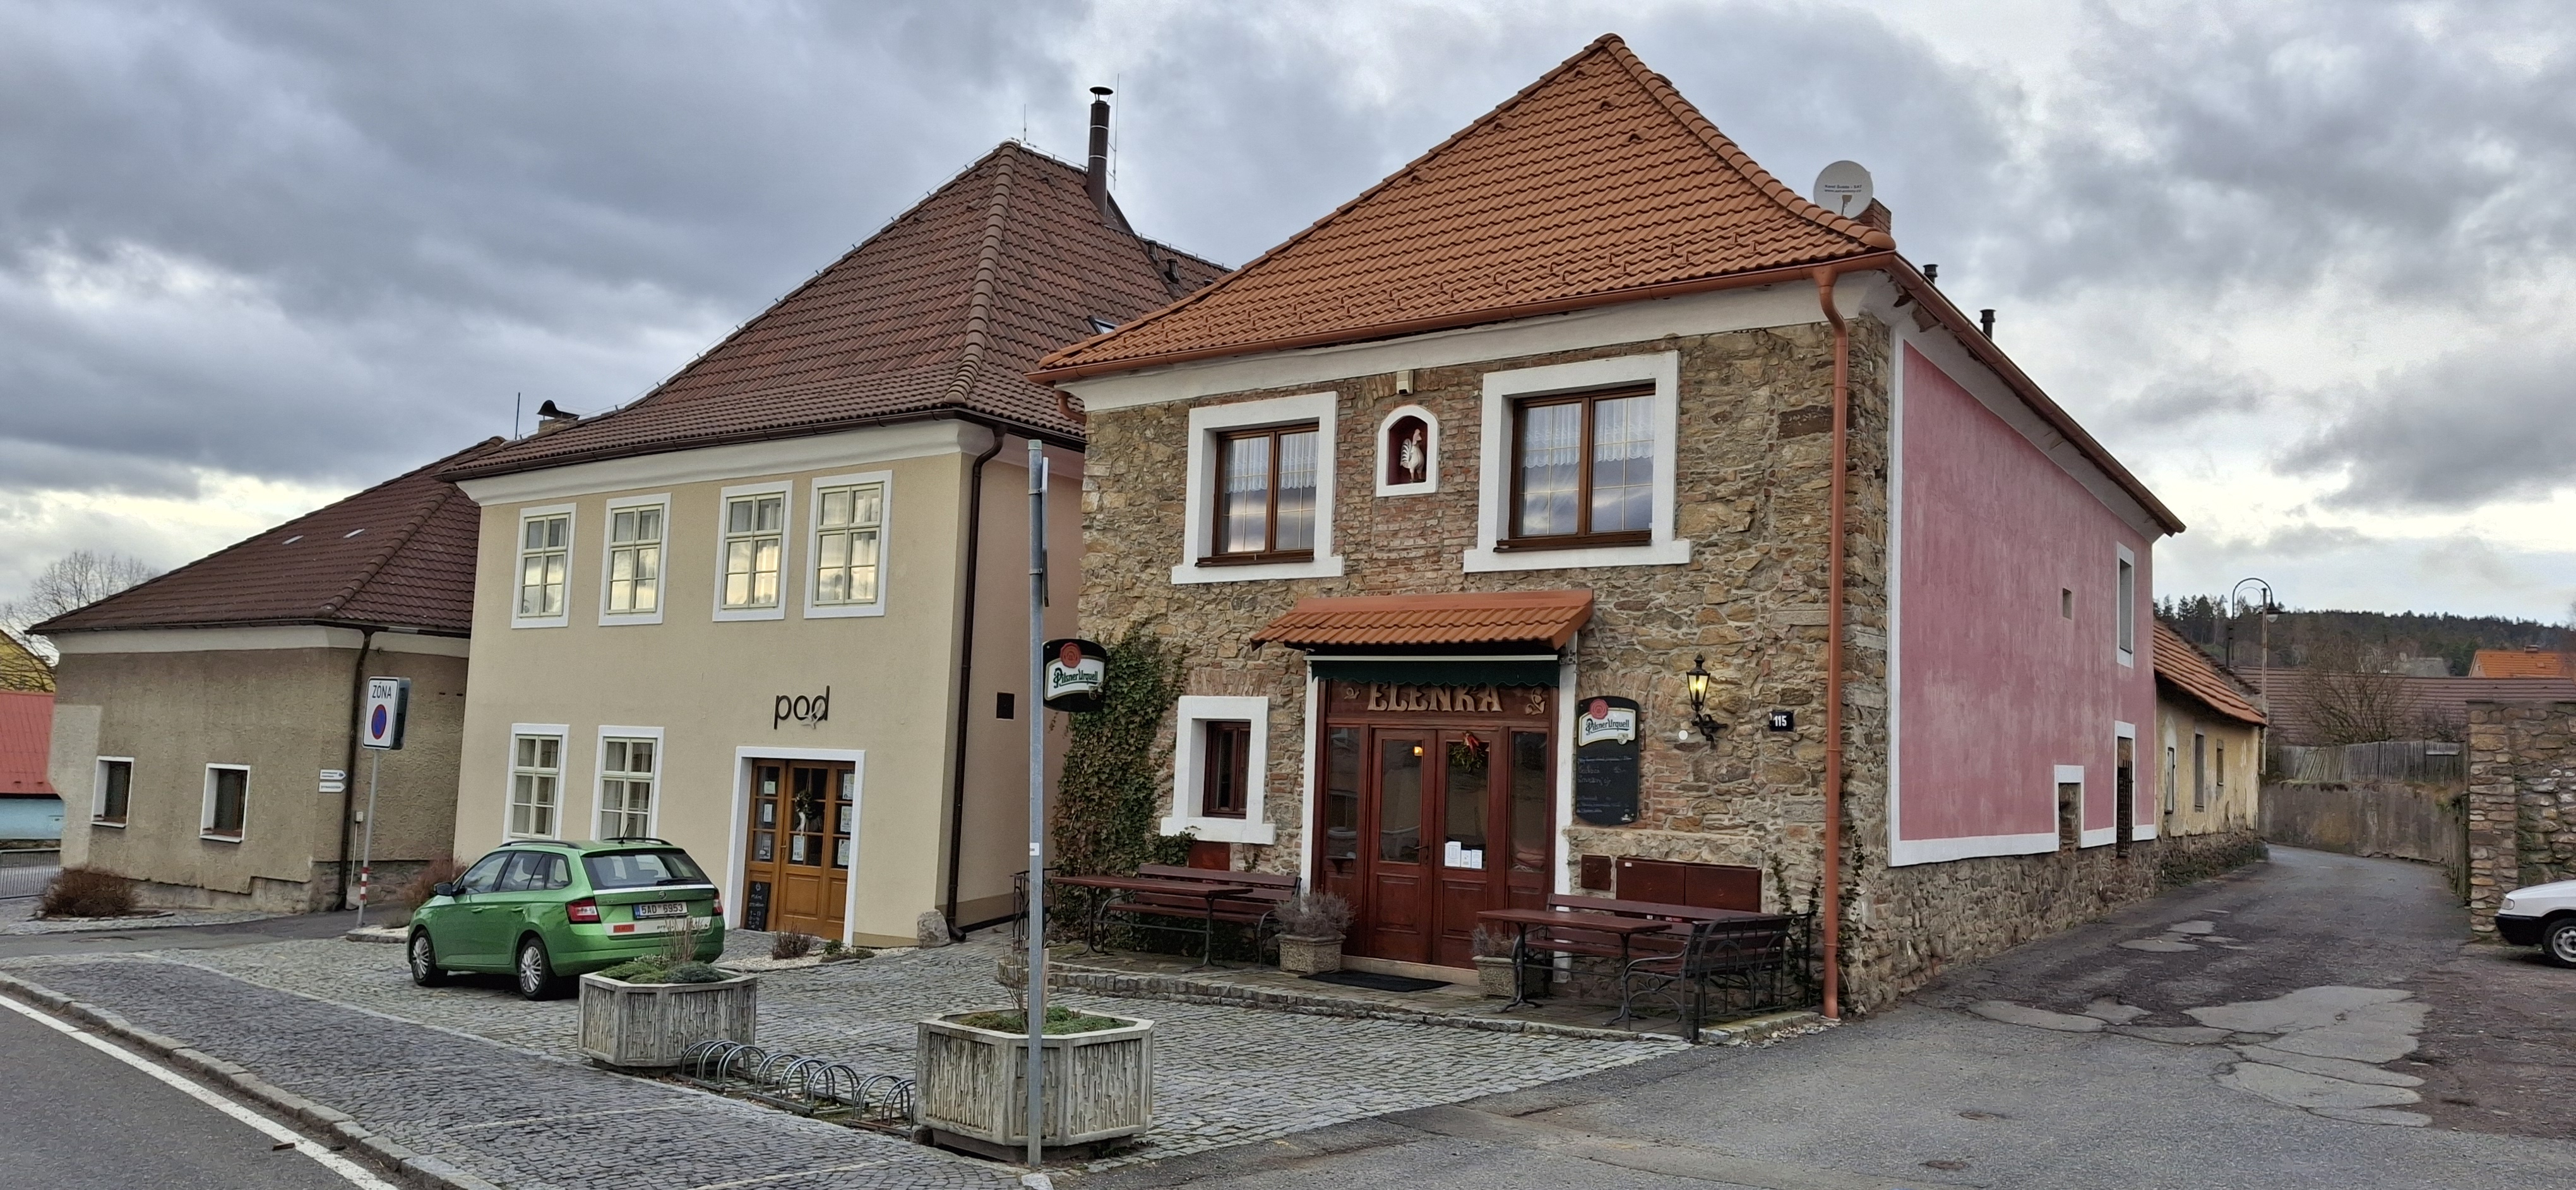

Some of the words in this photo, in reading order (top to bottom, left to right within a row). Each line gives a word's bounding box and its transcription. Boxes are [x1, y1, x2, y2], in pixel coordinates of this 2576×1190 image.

[1053, 667, 1078, 688] Pilsner
[1078, 668, 1098, 685] Urquell
[372, 682, 391, 699] ZÓNA
[1367, 681, 1503, 712] ELENKA
[773, 685, 830, 730] pod
[1585, 718, 1609, 735] Pilsner
[1608, 719, 1630, 731] Urquell
[1774, 715, 1787, 727] 115
[641, 905, 657, 915] 5AD
[663, 903, 684, 913] 6953
